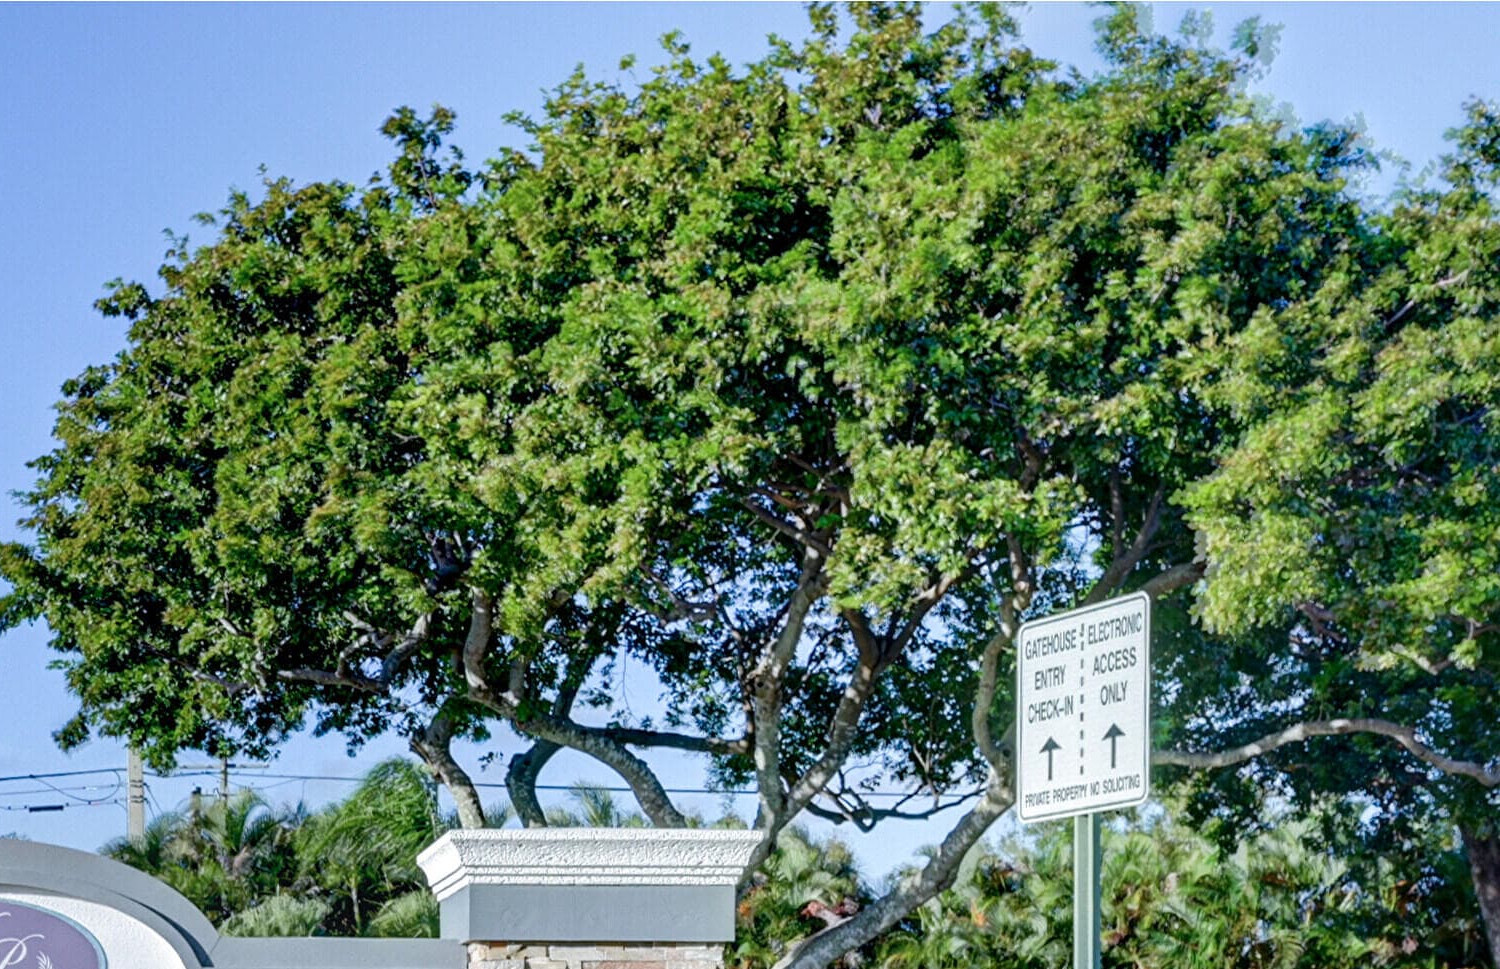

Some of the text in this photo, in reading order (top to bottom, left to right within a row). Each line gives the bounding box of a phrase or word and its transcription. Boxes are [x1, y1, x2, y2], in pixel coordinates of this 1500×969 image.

[1088, 612, 1143, 645] ELECTRONIC
[1025, 629, 1077, 660] GATEHOUSE
[1092, 646, 1137, 676] ACCESS
[1034, 665, 1067, 690] ENTRY
[1100, 680, 1128, 706] ONLY
[1028, 695, 1074, 724] CHECK-IN
[1025, 789, 1051, 808] PRIVATE
[1052, 785, 1088, 805] PROPERTY
[1089, 780, 1100, 796] NO
